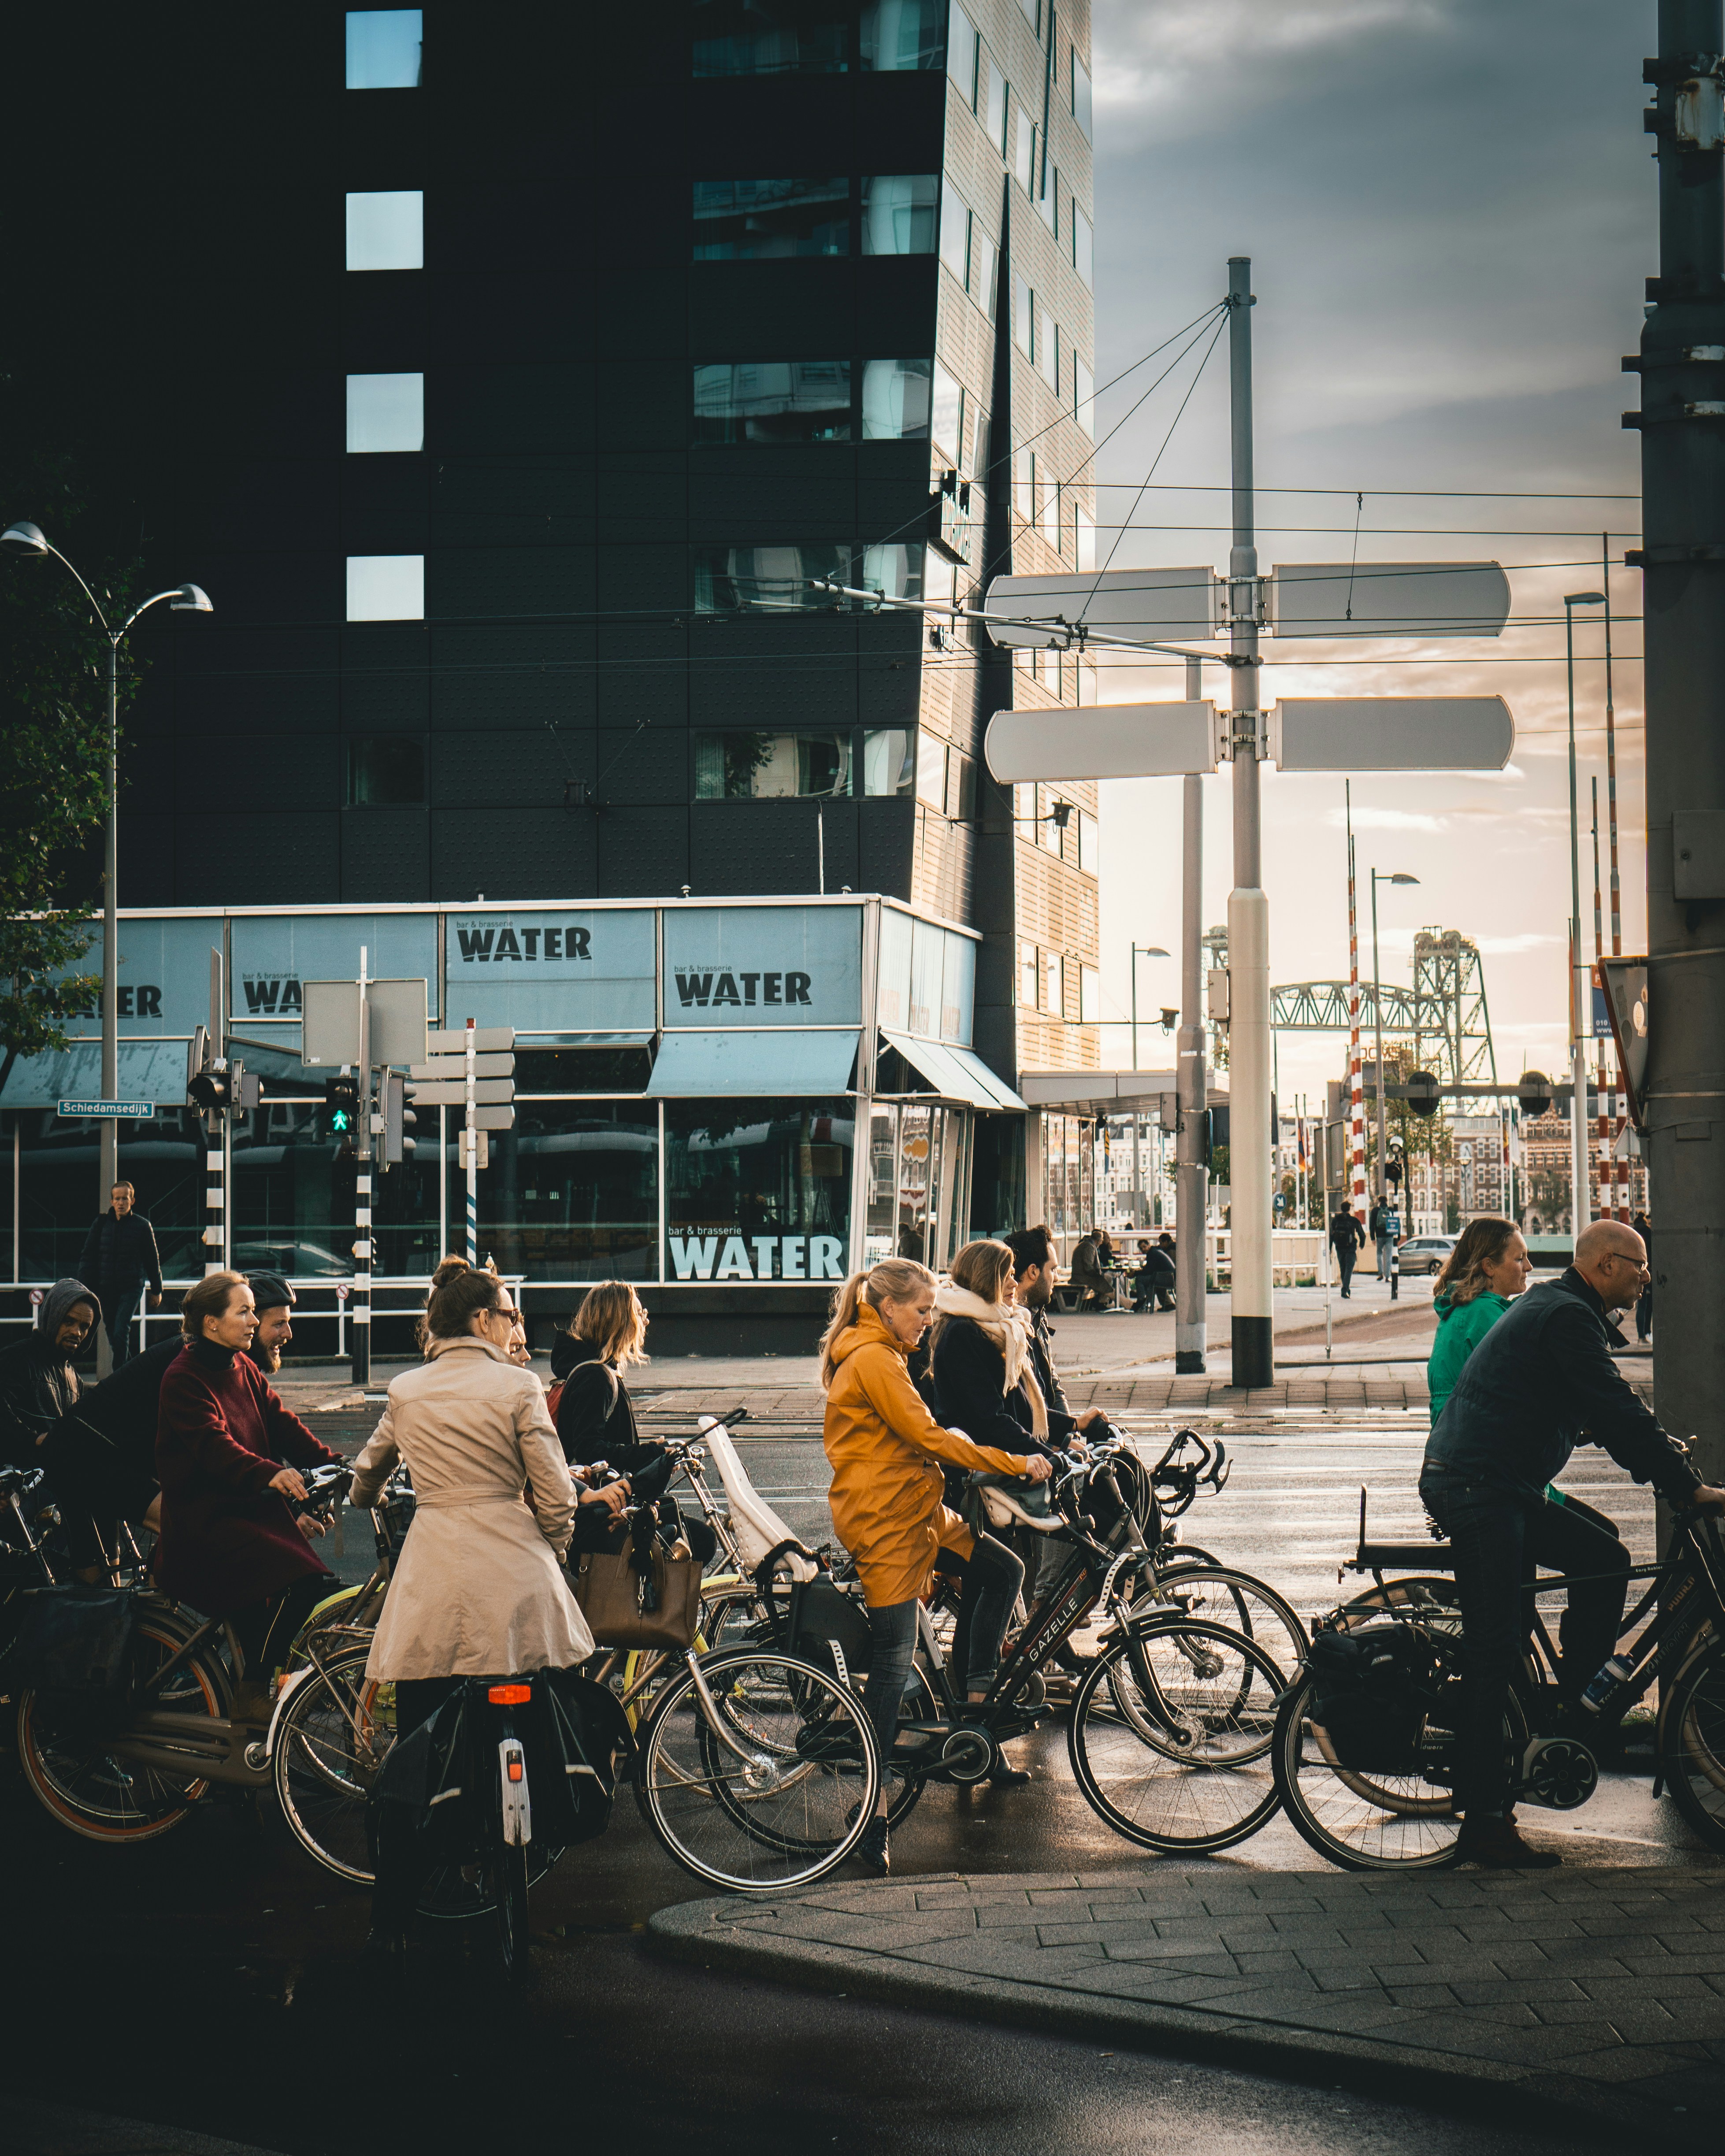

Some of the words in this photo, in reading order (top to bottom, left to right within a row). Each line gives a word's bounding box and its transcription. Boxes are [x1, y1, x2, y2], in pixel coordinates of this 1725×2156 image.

[457, 927, 592, 962] WATER
[675, 972, 812, 1007] WATER
[63, 1103, 148, 1116] Schiedamsedijk
[668, 1226, 683, 1235] bar
[687, 1226, 694, 1235] &
[697, 1226, 742, 1235] brasserie
[669, 1236, 844, 1279] WATER
[1029, 1598, 1078, 1661] GAZELLE
[1642, 1622, 1690, 1679] idworx
[1599, 1682, 1620, 1704] Tacx
